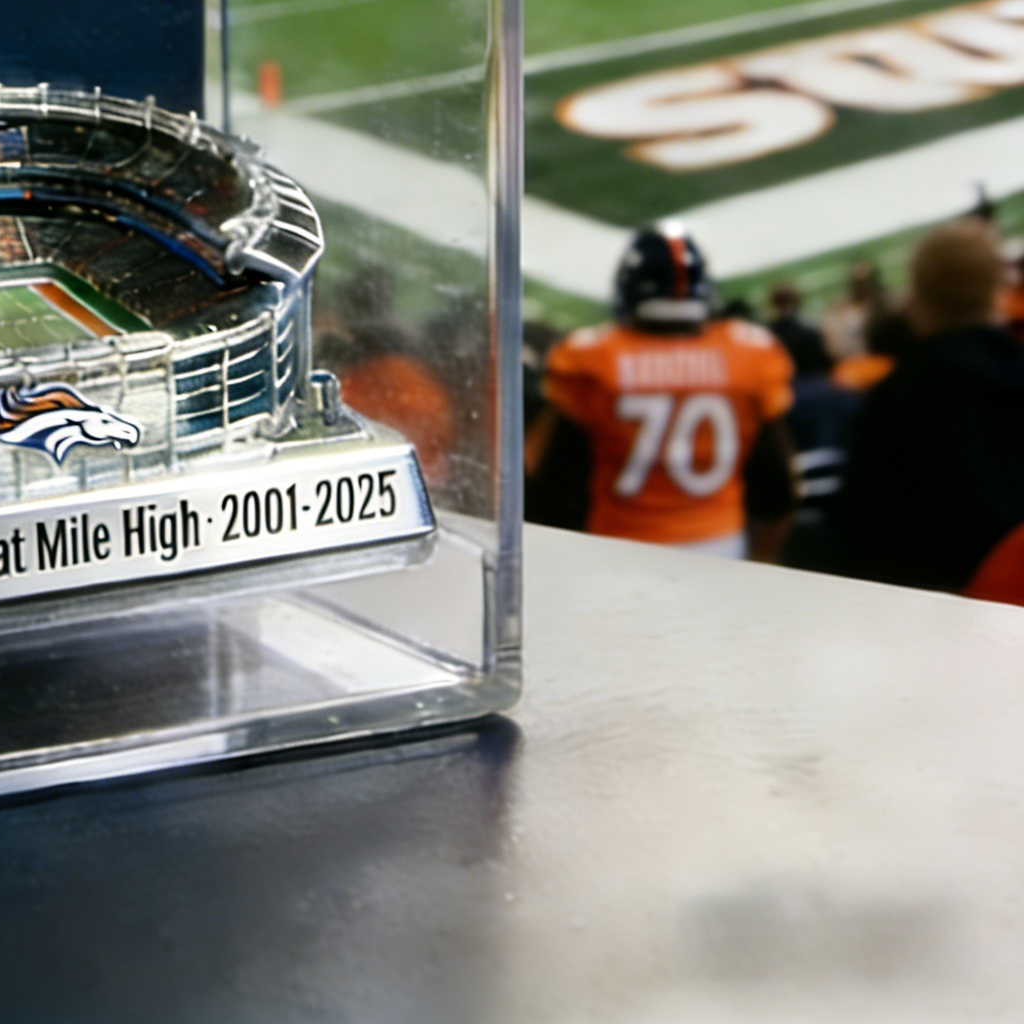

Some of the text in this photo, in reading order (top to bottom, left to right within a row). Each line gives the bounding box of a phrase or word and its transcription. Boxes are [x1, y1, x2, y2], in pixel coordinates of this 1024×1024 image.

[615, 392, 740, 497] 70
[35, 512, 111, 571] Mile
[122, 499, 201, 562] High
[220, 469, 397, 543] 2001-2025
